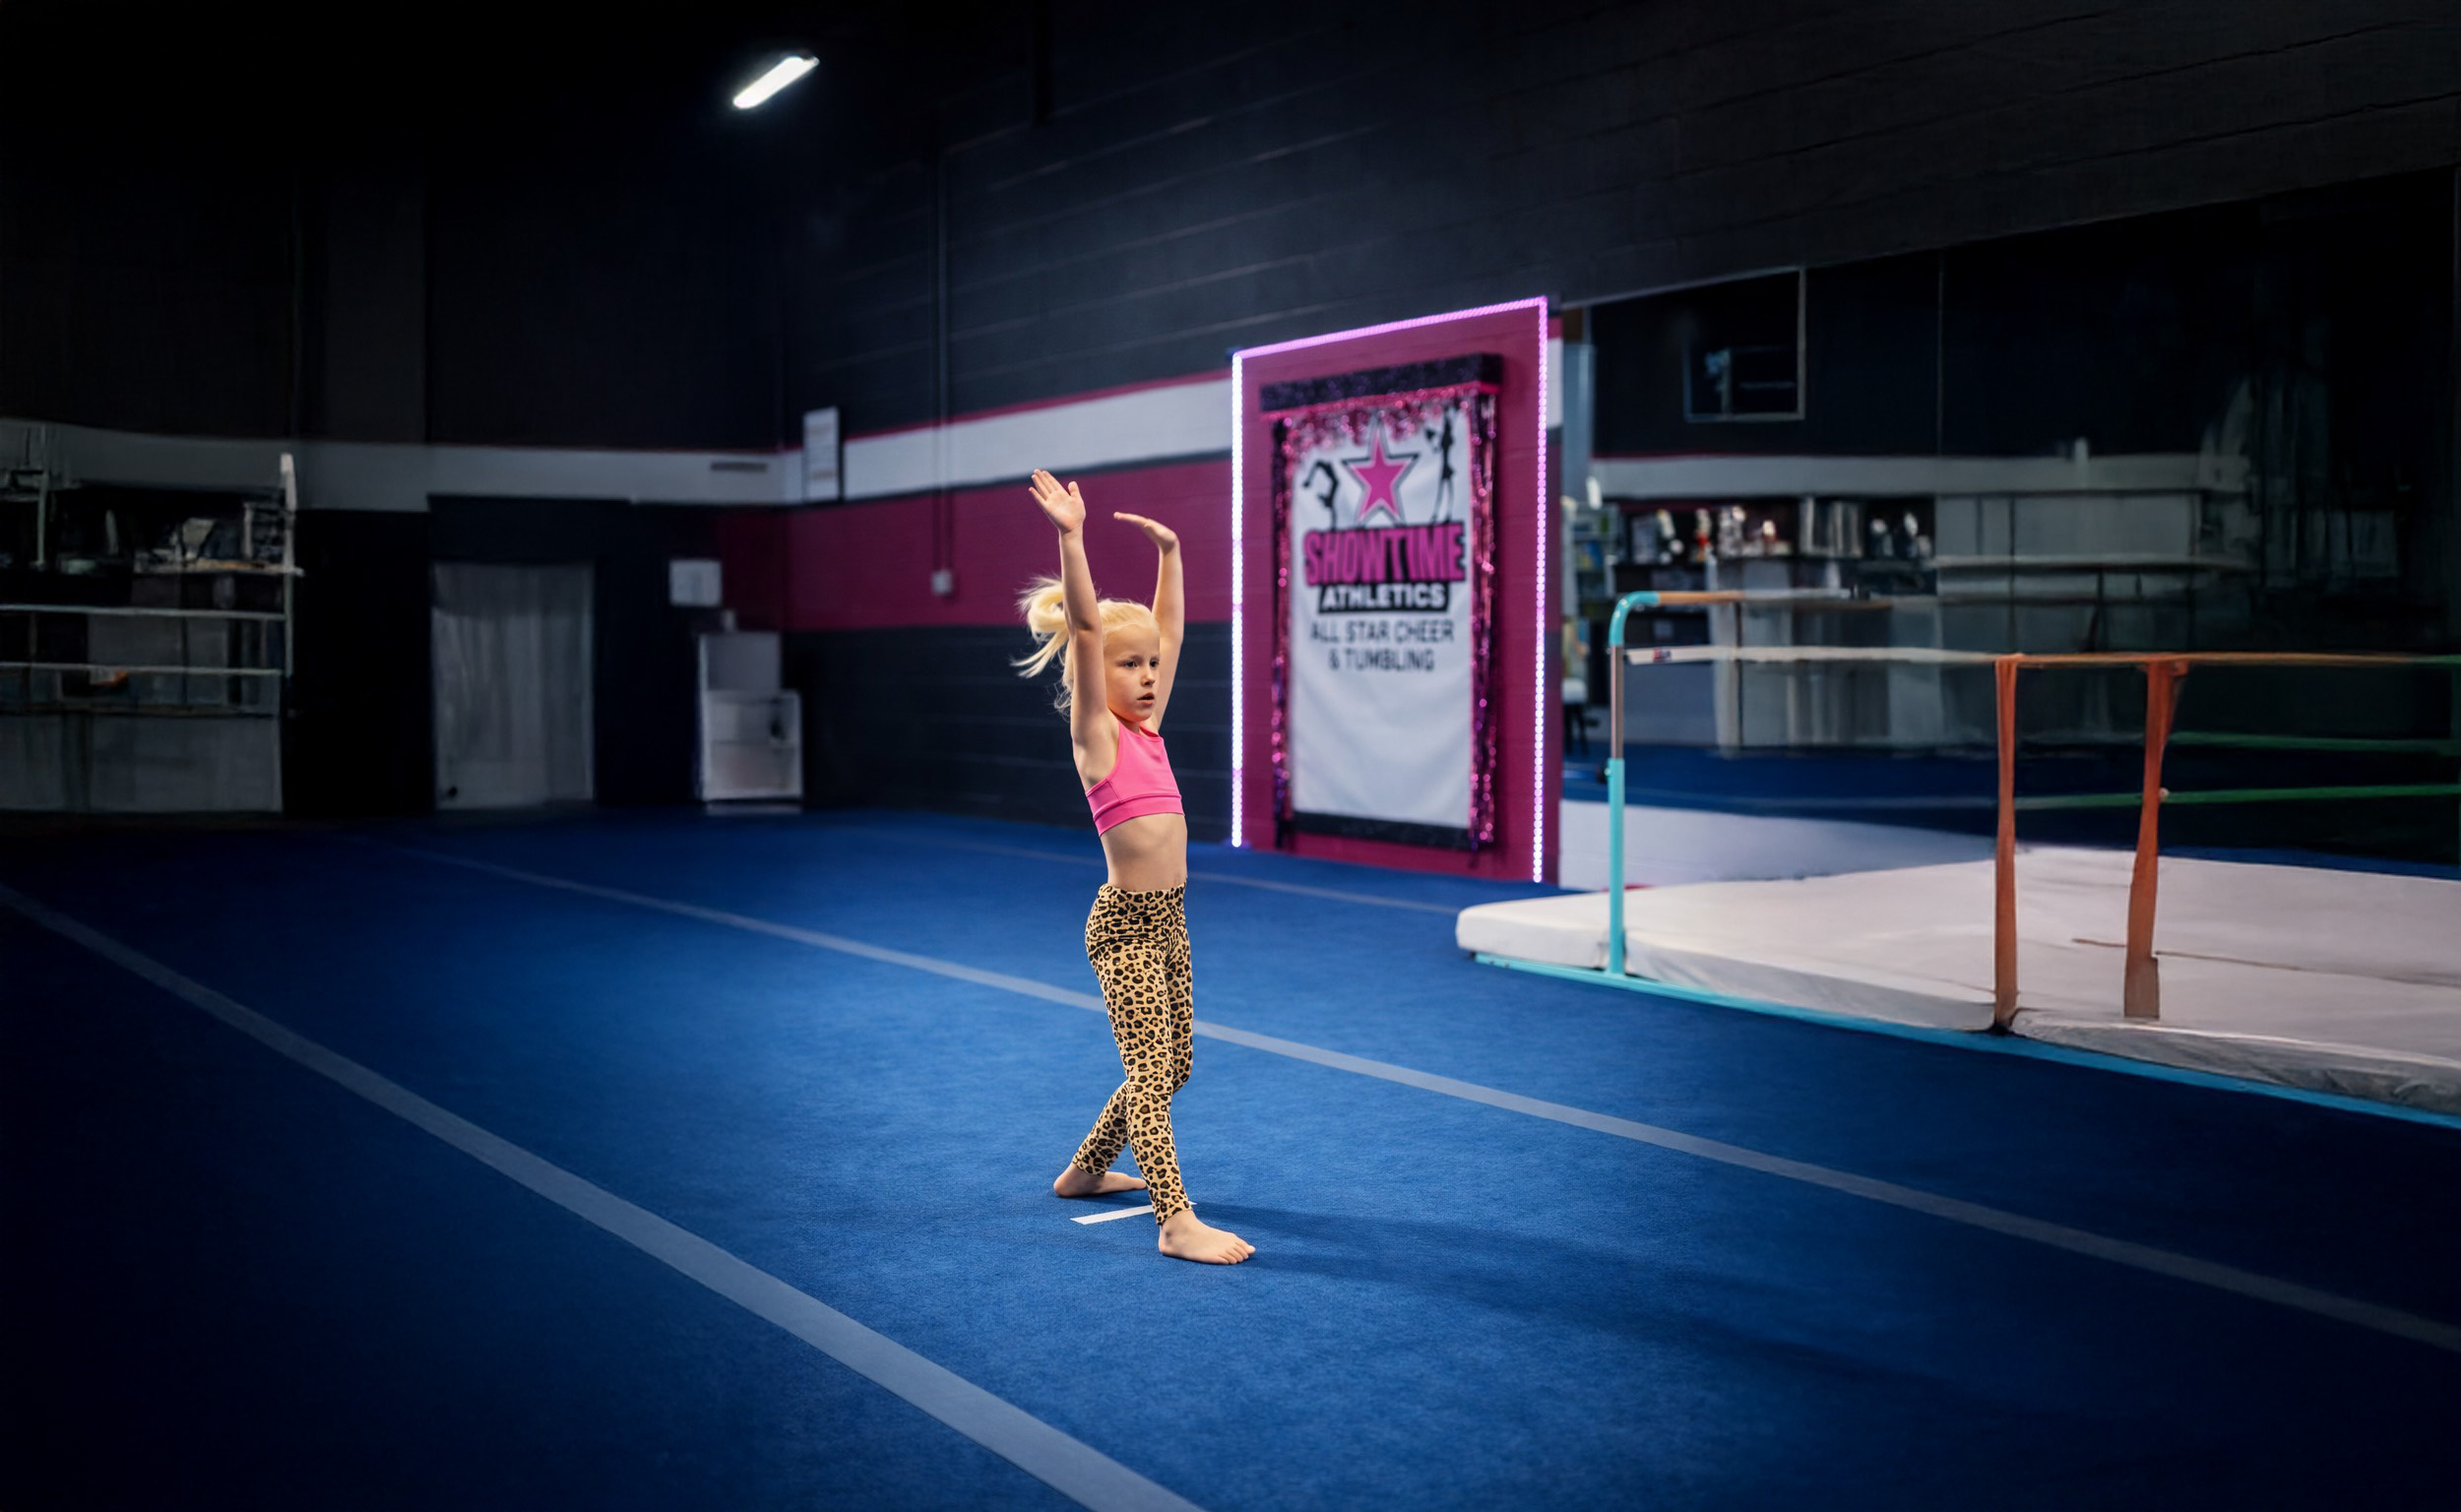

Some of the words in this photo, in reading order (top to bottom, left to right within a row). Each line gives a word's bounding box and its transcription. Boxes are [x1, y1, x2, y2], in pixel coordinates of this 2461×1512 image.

[1304, 523, 1466, 586] SHOWTIME
[1320, 583, 1447, 610] ATHLETICS
[1310, 621, 1339, 643] ALL
[1346, 620, 1390, 643] STAR
[1394, 619, 1455, 643] CHEER
[1330, 648, 1340, 671] &
[1344, 648, 1435, 671] TUMBLING
